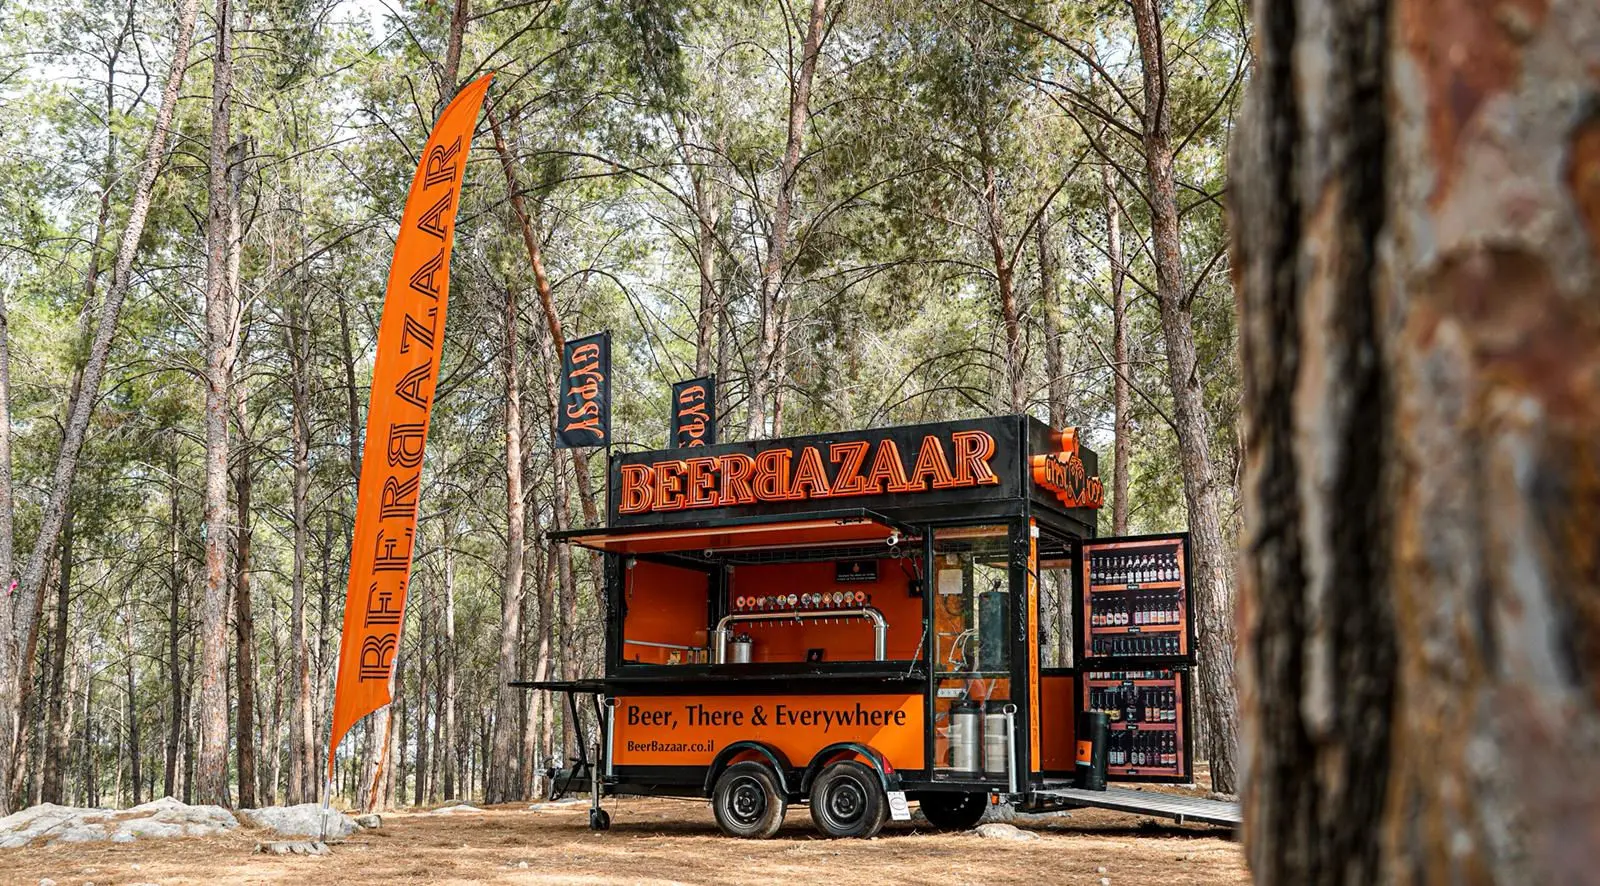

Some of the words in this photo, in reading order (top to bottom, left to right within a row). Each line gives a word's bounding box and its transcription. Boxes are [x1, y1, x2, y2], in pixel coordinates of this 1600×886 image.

[359, 135, 462, 682] BEERBAZAAR
[564, 343, 605, 439] GYPSY
[677, 385, 710, 448] GYP
[618, 430, 999, 514] BEERBAZAAR
[627, 740, 714, 752] BeerBazaar.co.il
[628, 705, 678, 730] Beer,
[685, 704, 744, 726] There
[751, 705, 768, 726] &
[776, 703, 906, 733] Everywhere
